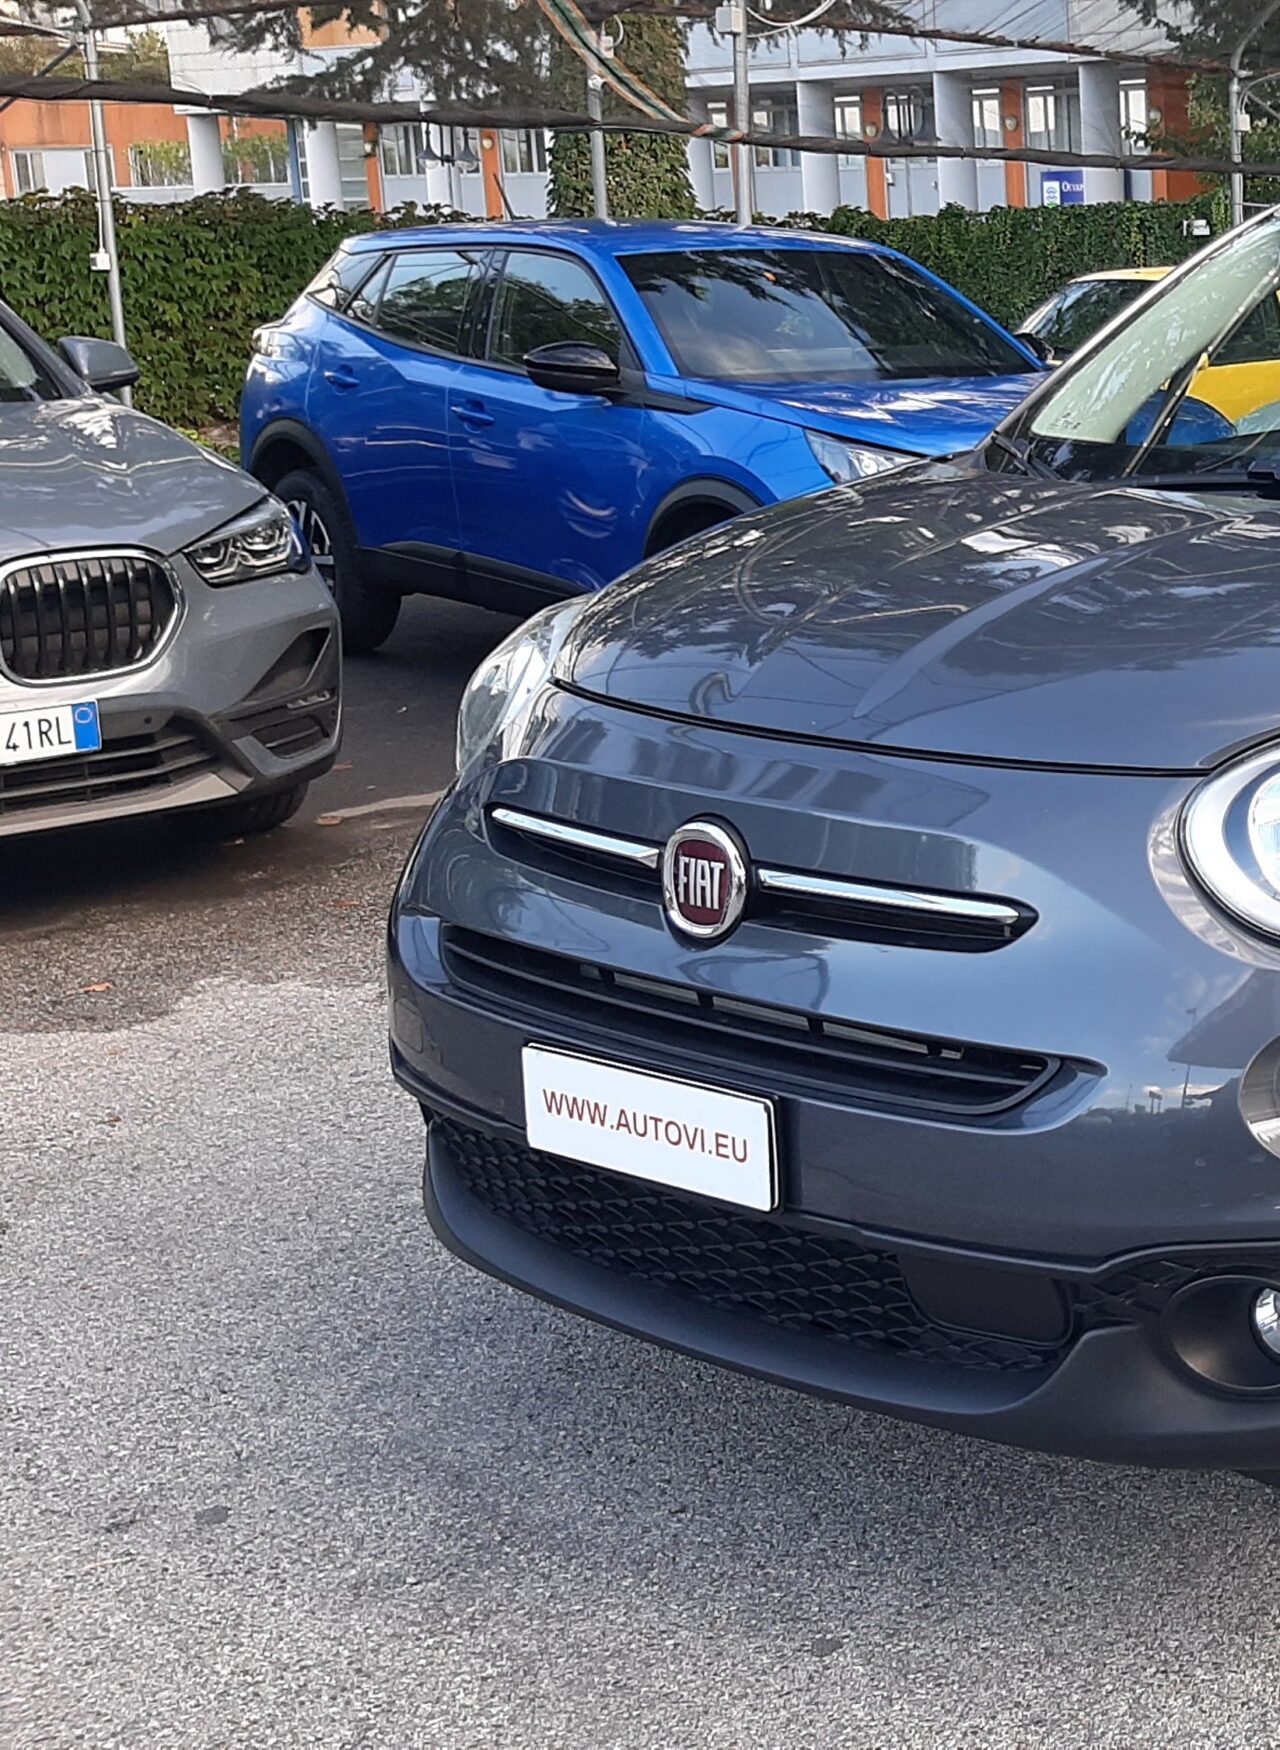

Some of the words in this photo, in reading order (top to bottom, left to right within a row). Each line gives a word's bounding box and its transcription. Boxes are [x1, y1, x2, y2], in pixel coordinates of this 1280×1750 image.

[5, 716, 73, 752] 41RL
[678, 855, 725, 910] FIAT
[543, 1088, 748, 1163] WWW.AUTOVI.EU
